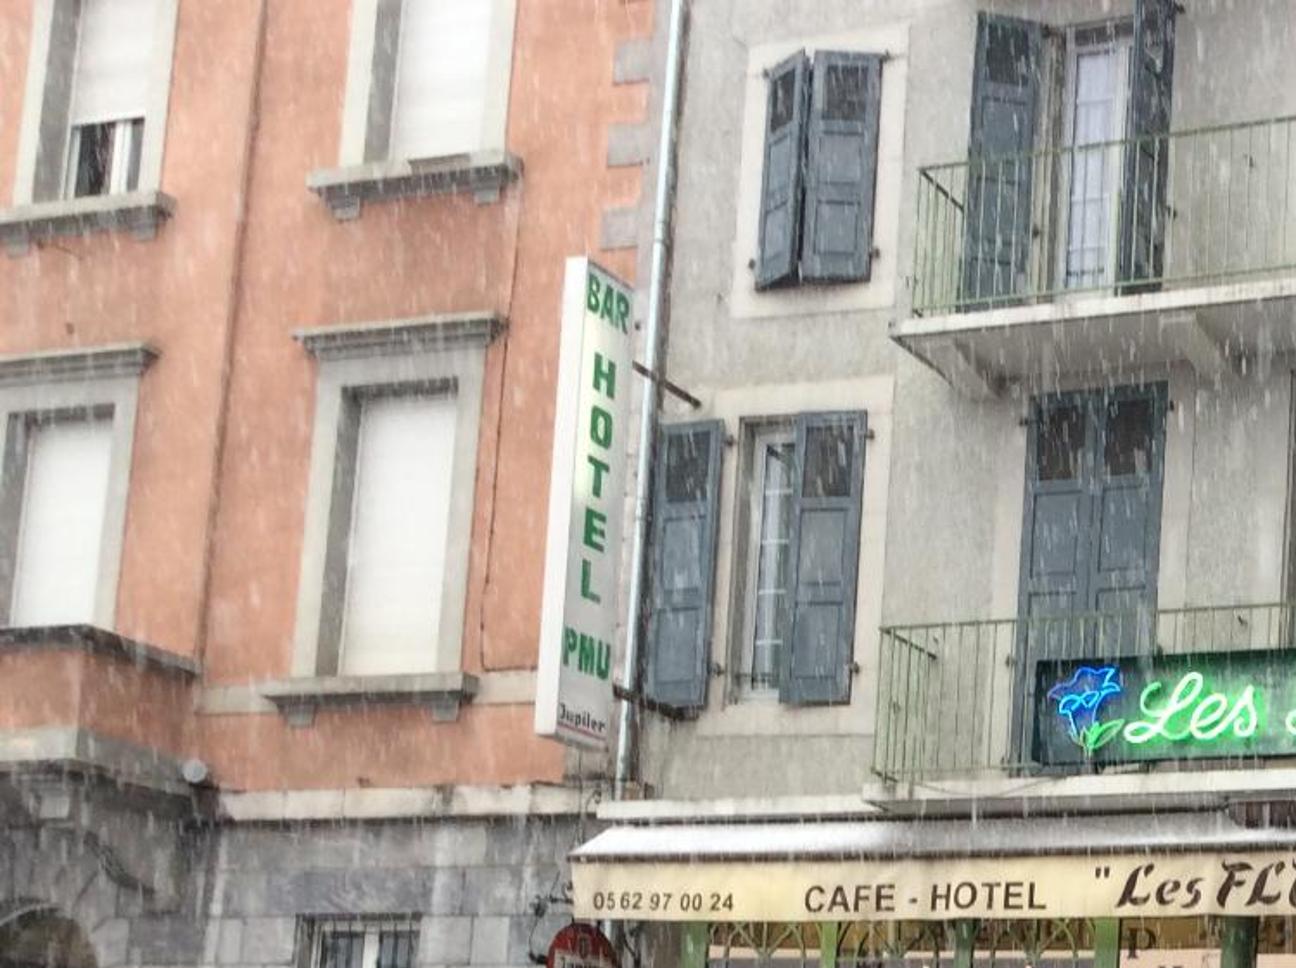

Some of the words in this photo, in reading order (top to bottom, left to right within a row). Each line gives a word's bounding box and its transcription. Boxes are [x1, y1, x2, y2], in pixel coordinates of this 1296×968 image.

[587, 272, 630, 335] BAR
[581, 350, 616, 602] HOTEL
[563, 625, 610, 681] PMU
[560, 702, 606, 732] Jupiler
[1122, 670, 1258, 744] Les
[594, 892, 616, 910] 05
[620, 892, 642, 910] 62
[649, 892, 672, 912] 97
[681, 892, 703, 912] 00
[710, 892, 734, 912] 24
[804, 883, 896, 914] CAFE
[930, 881, 1047, 912] HOTEL
